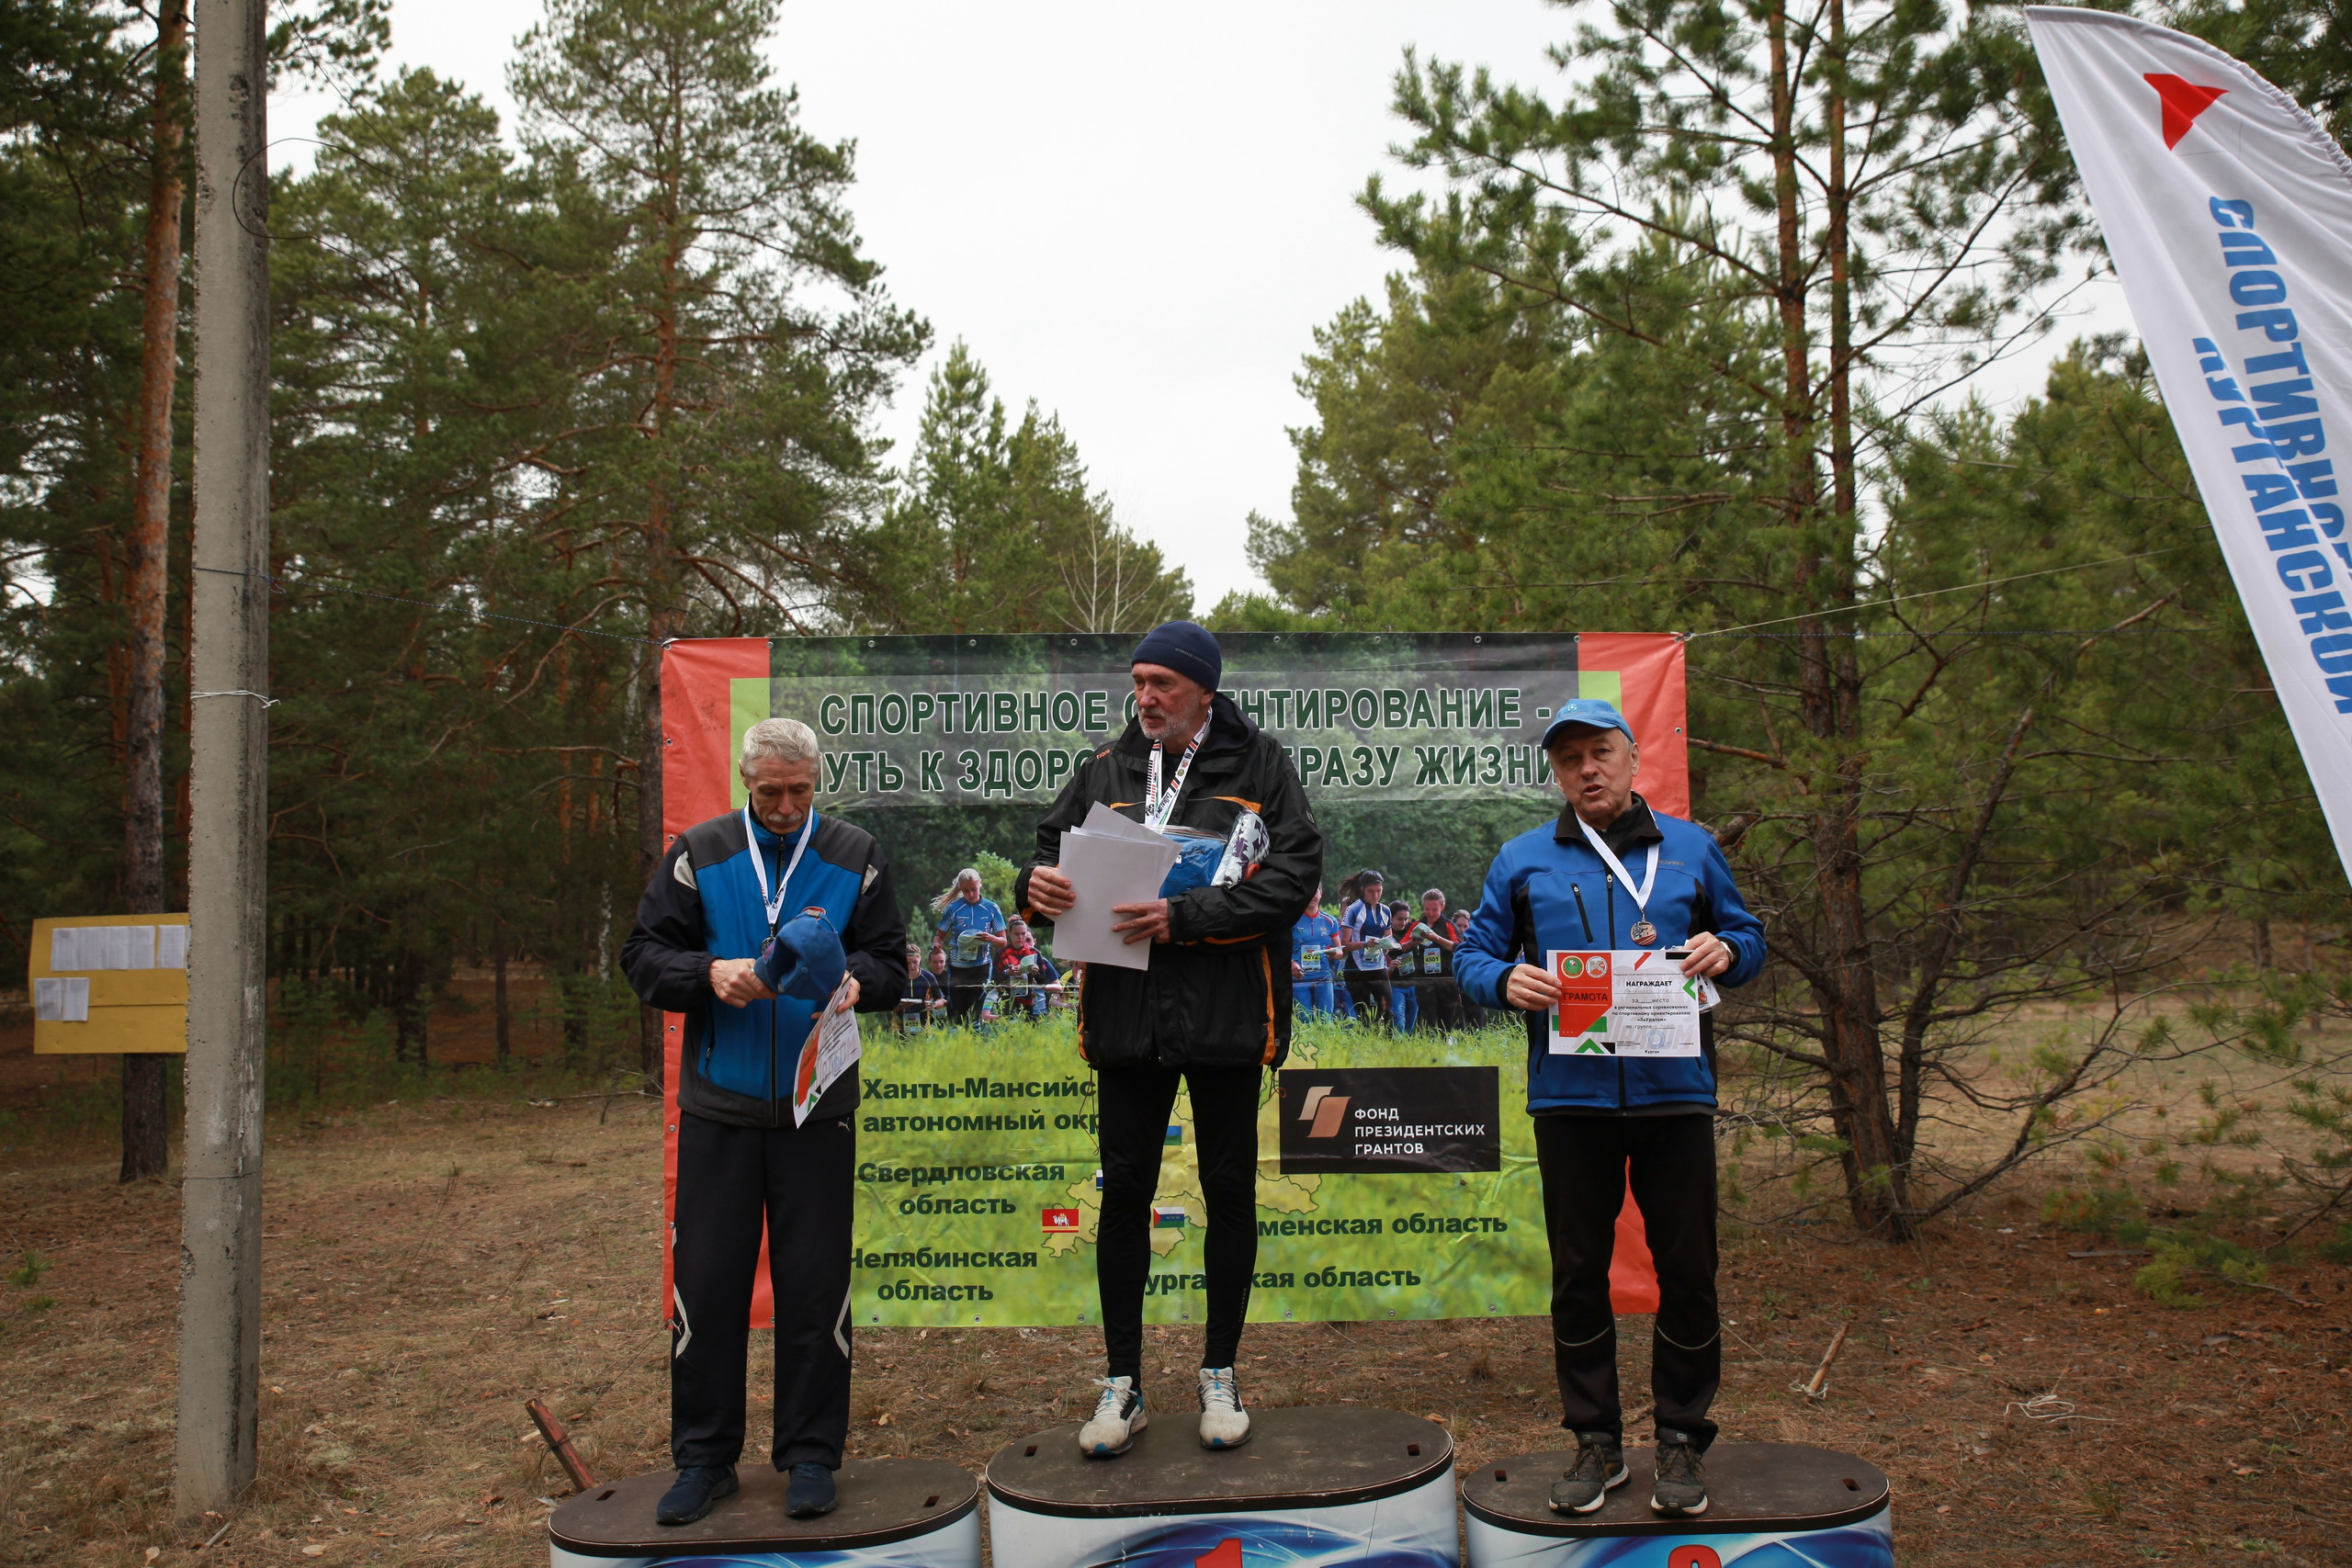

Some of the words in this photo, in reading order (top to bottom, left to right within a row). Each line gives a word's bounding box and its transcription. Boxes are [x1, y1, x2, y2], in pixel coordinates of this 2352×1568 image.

[2209, 196, 2352, 581] СПОРТИВНО
[820, 691, 1109, 736] СПОРТИВНОЕ
[1124, 687, 1521, 731] НТИРОВАНИЕ
[921, 750, 944, 793] К
[1283, 745, 1401, 789] РАЗУ
[1563, 992, 1609, 1001] ГРАМОТА
[862, 1076, 1097, 1100] Ханты-Мансийс
[862, 1109, 1046, 1133] автономный
[1054, 1112, 1100, 1134] окр
[1353, 1107, 1400, 1122] ФОНД
[1354, 1122, 1487, 1138] ПРЕЗИДЕНТСКИХ
[1354, 1142, 1425, 1156] ГРАНТОВ
[856, 1162, 1066, 1188] Свердловская
[899, 1197, 1017, 1215] область
[1257, 1215, 1384, 1237] менская
[1392, 1212, 1509, 1234] область
[1303, 1265, 1421, 1288] область
[876, 1280, 994, 1302] область
